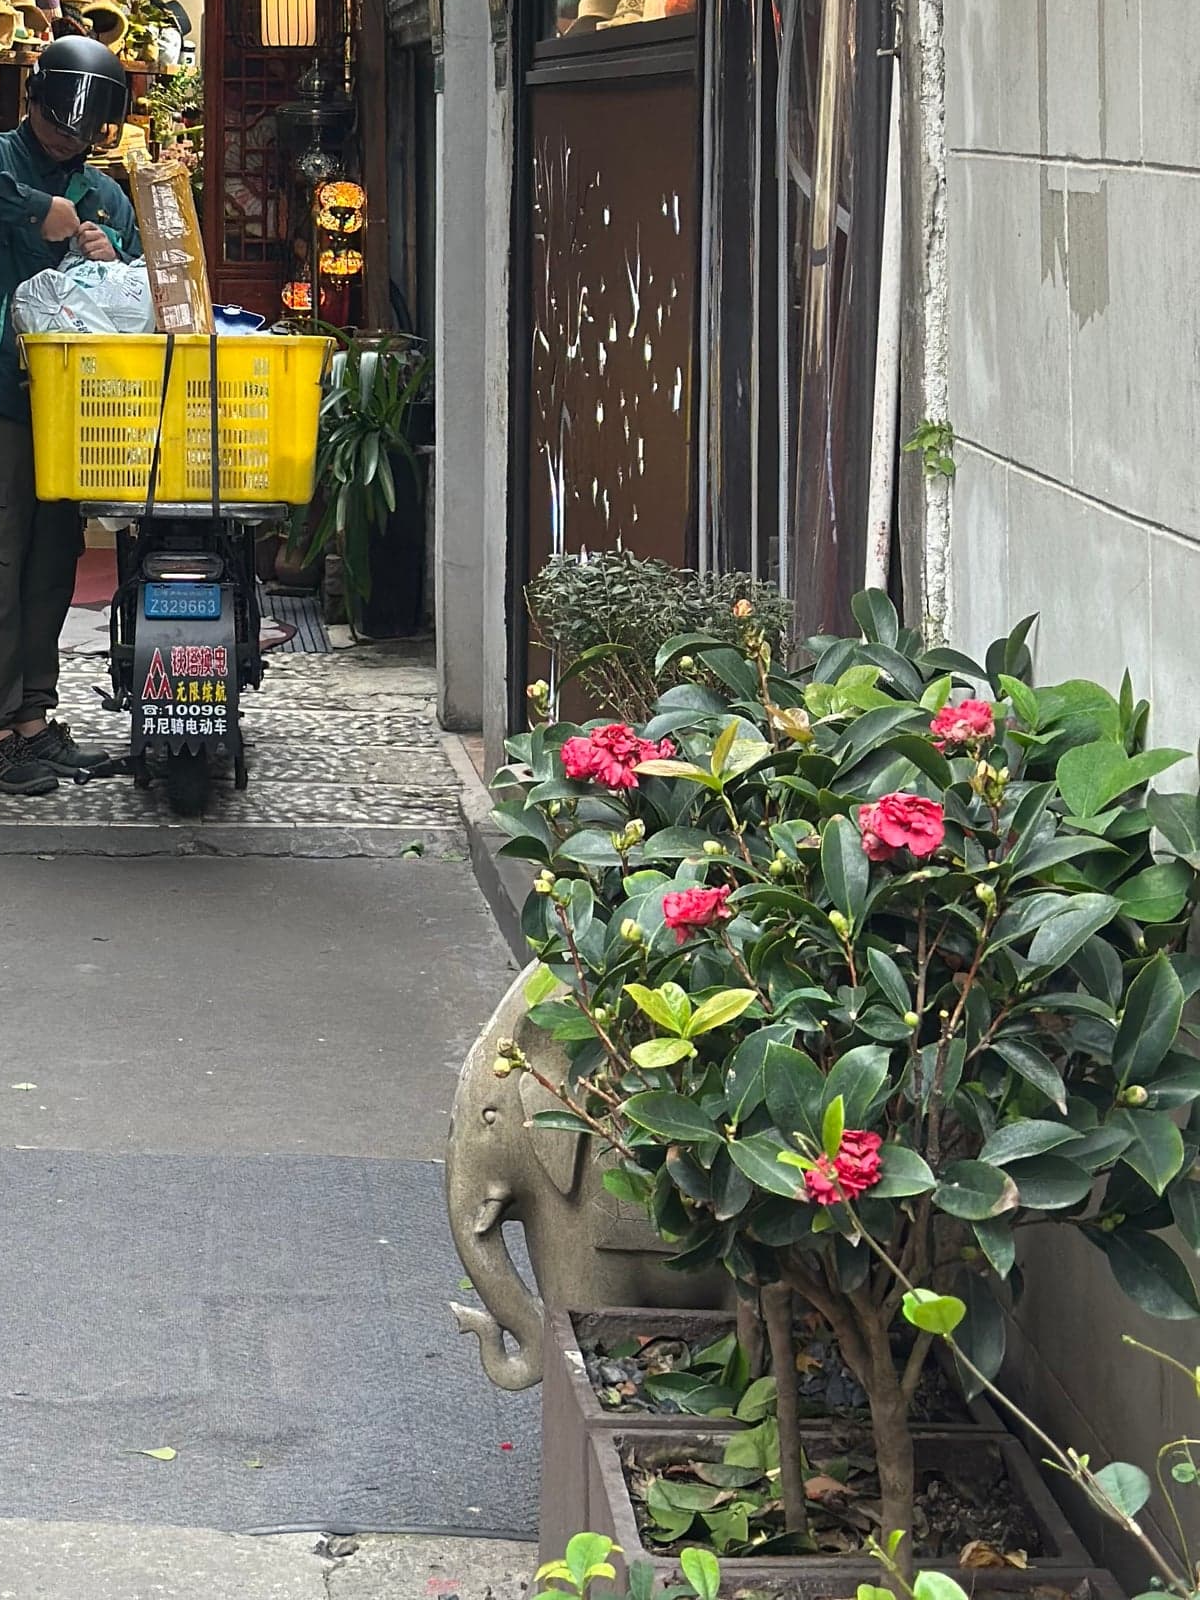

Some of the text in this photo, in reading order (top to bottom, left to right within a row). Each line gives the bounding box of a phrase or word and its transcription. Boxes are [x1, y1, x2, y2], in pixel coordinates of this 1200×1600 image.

[150, 599, 216, 614] Z329663
[171, 645, 229, 678] 铁塔换电
[176, 680, 228, 703] 无限续航
[141, 717, 228, 736] 丹尼骑电动车
